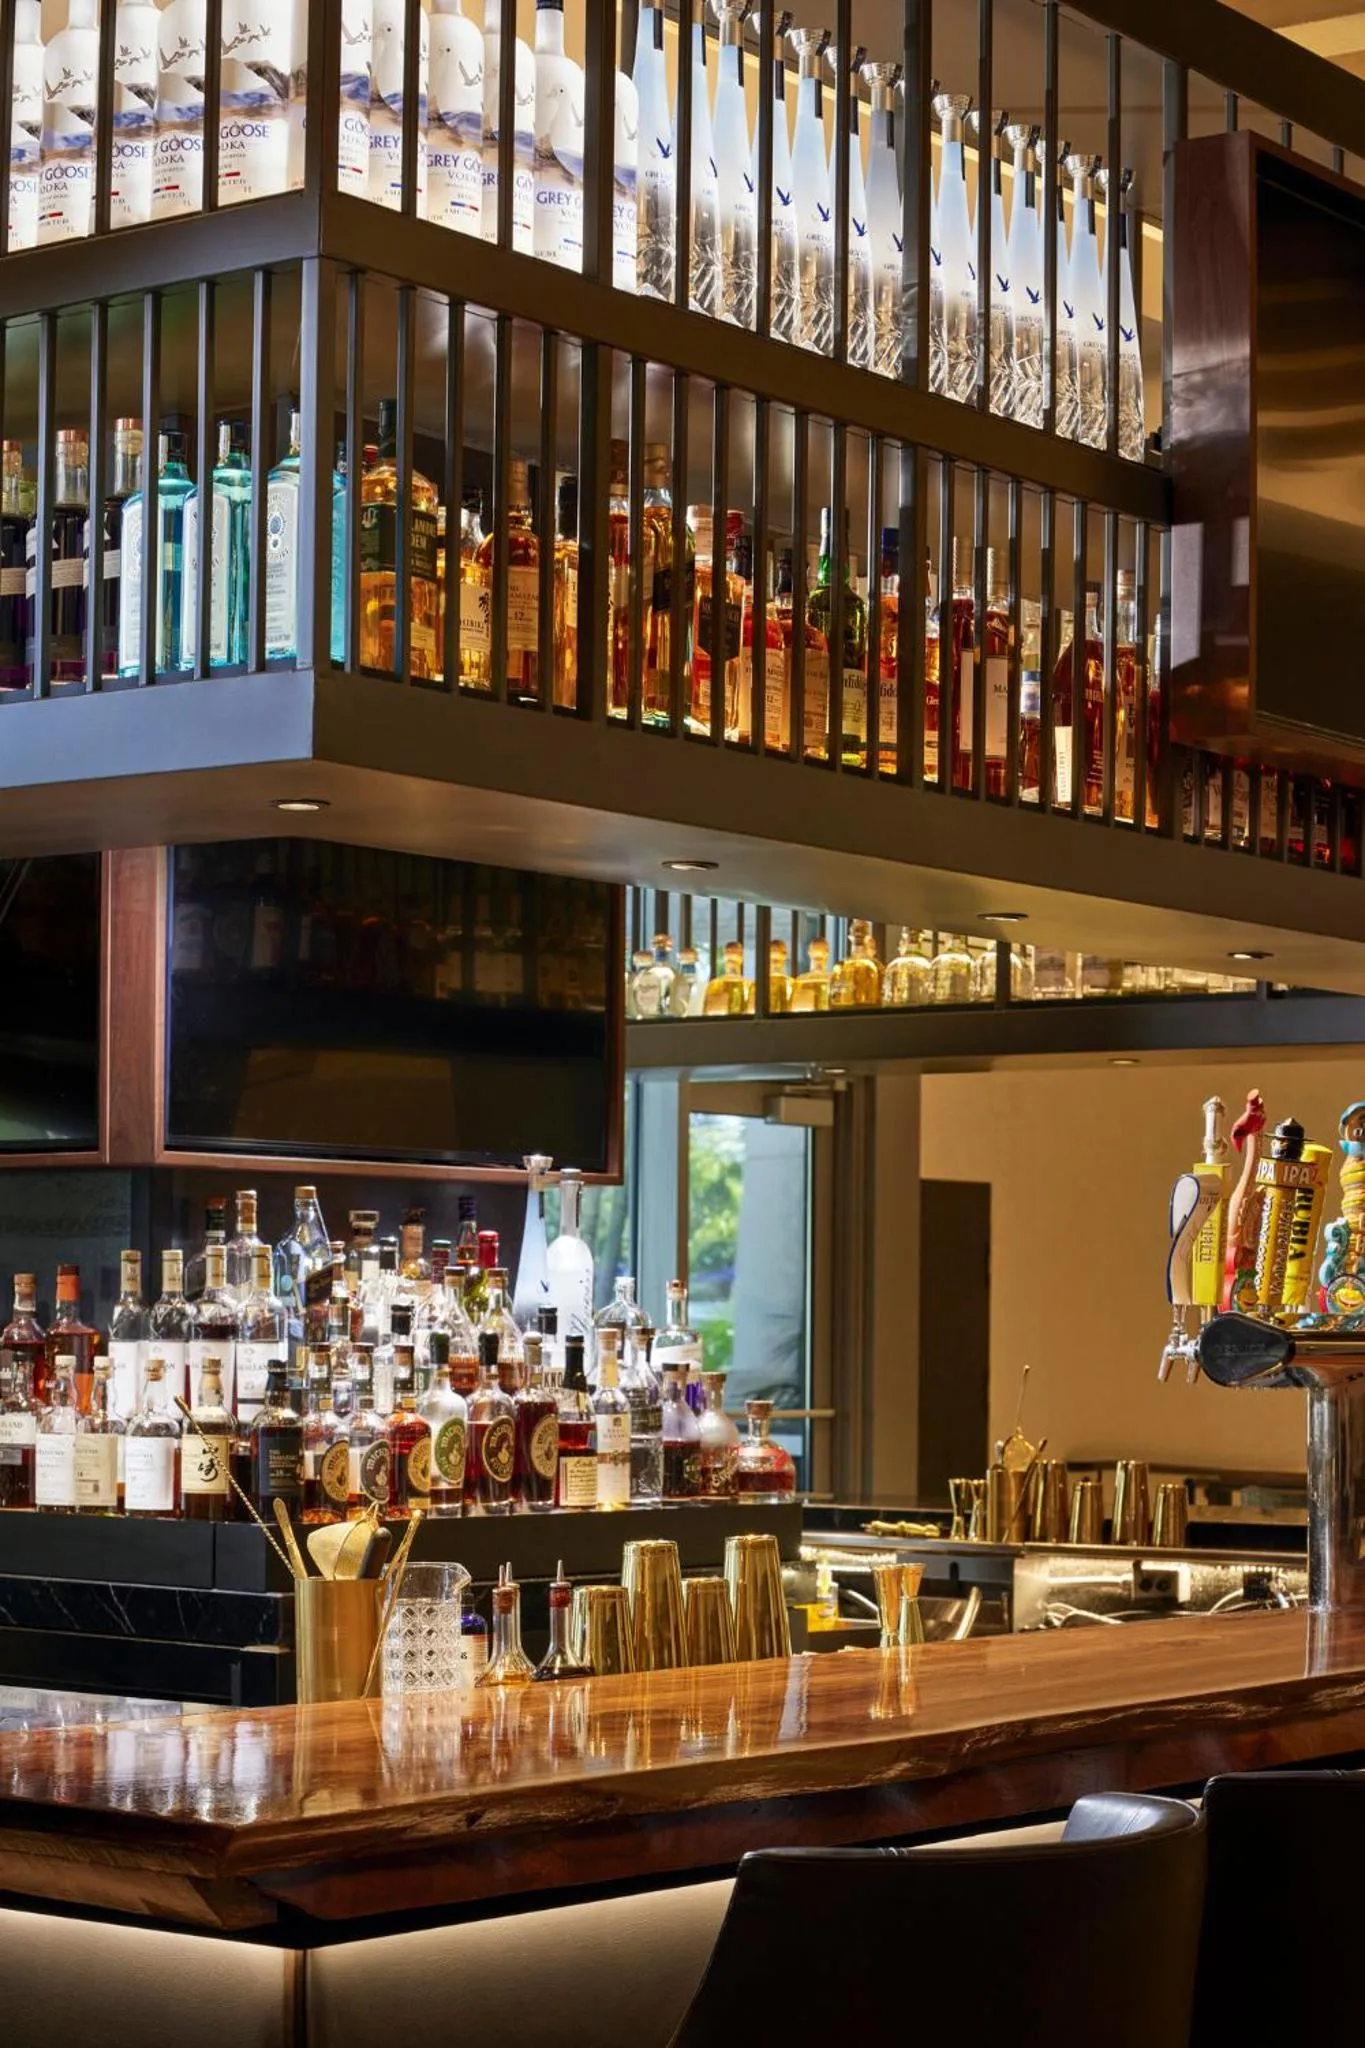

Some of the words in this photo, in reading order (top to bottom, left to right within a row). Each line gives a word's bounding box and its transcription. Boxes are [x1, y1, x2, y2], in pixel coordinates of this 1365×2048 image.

[220, 121, 270, 139] GOOSE
[160, 134, 202, 153] GOOS
[535, 190, 572, 206] GREY
[1282, 1165, 1310, 1185] IPA
[543, 1372, 563, 1389] KNO
